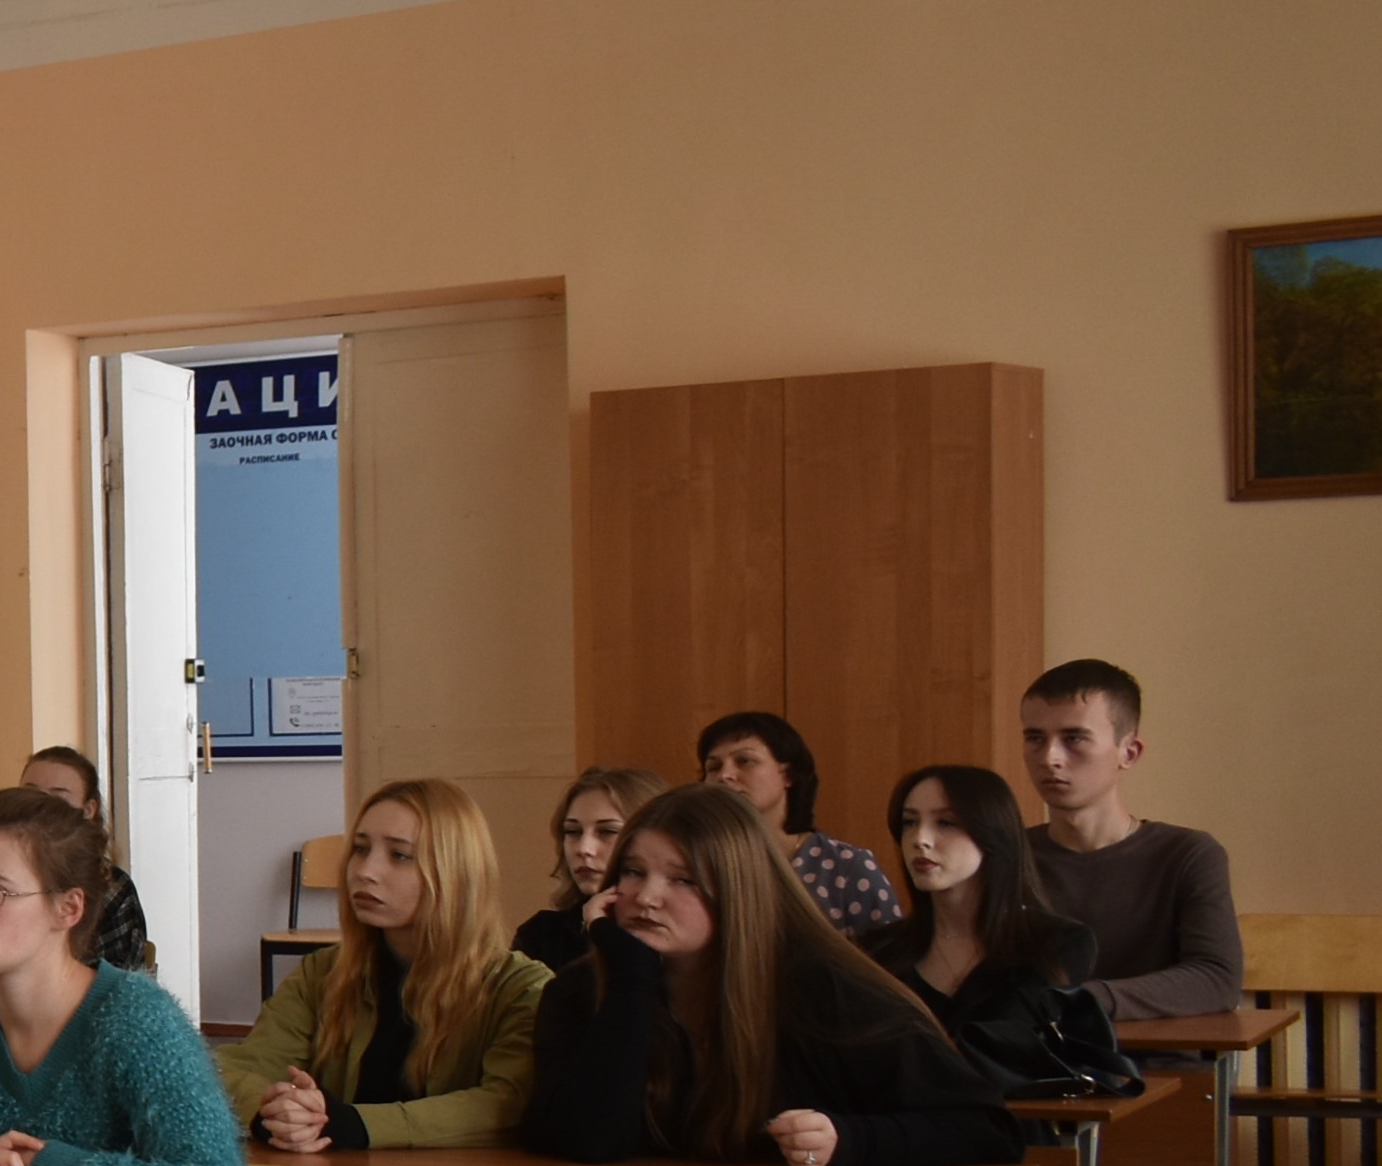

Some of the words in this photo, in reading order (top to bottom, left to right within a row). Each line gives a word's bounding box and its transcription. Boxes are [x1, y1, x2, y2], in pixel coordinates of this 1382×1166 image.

[210, 434, 272, 449] ЗАОЧНАЯ
[276, 431, 328, 444] ФОРМА
[239, 453, 300, 465] РАСПИСАНИЕ
